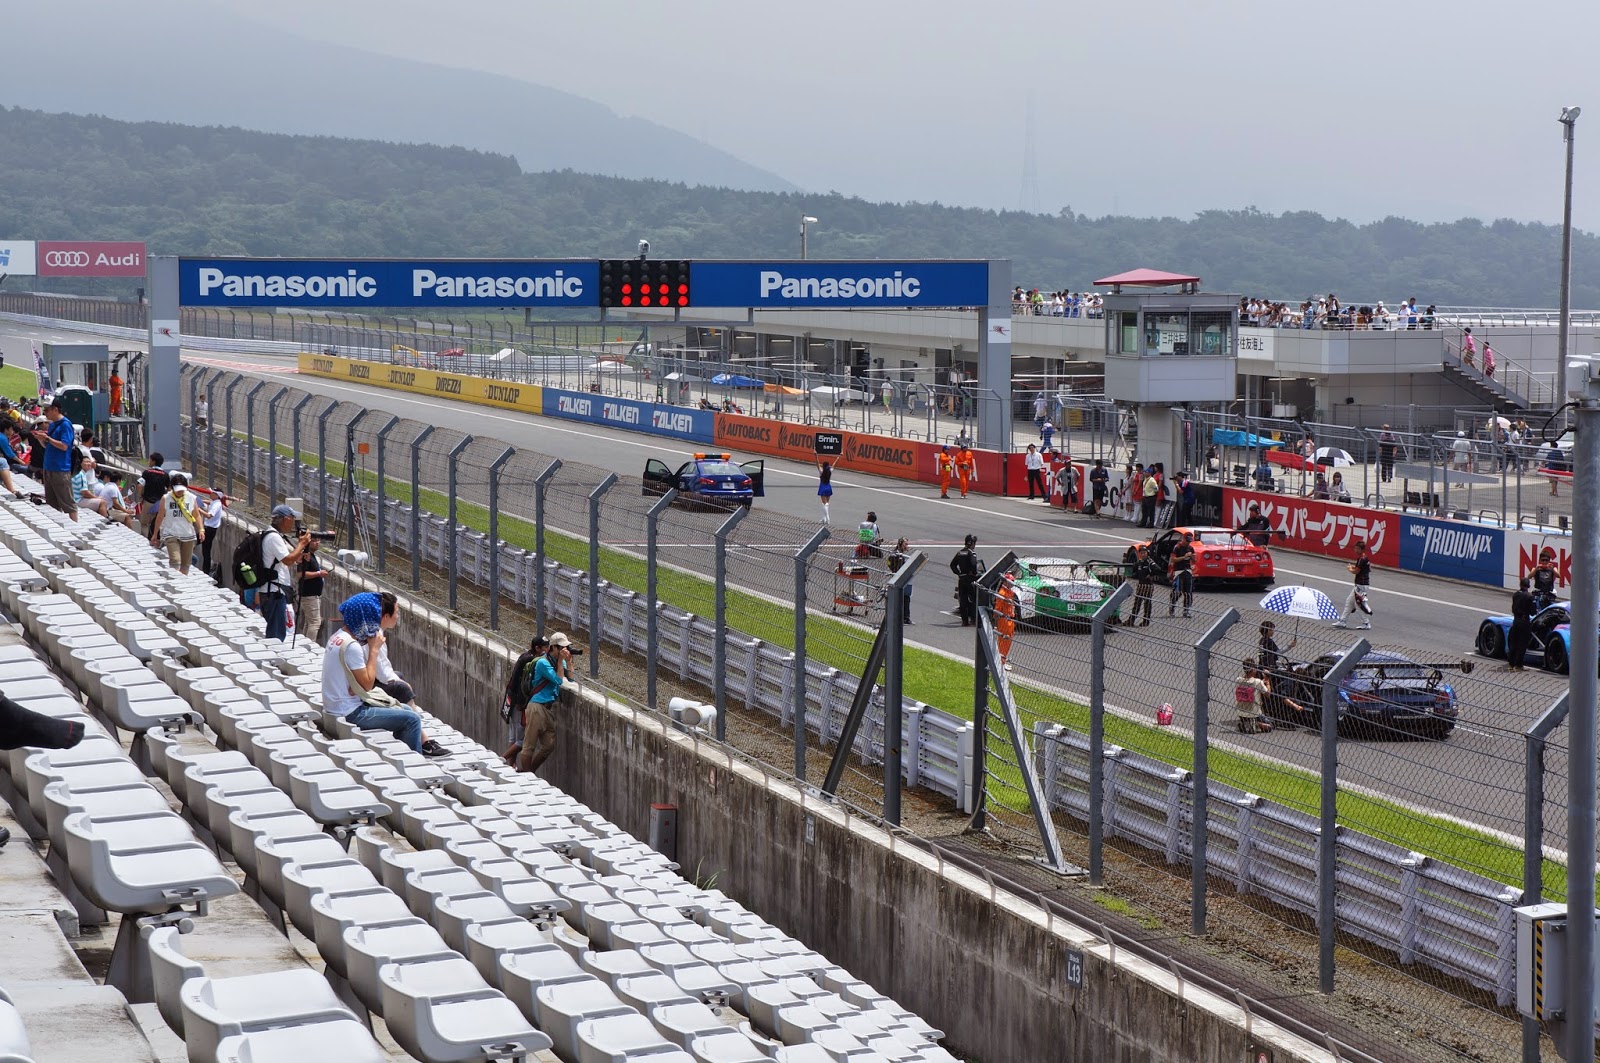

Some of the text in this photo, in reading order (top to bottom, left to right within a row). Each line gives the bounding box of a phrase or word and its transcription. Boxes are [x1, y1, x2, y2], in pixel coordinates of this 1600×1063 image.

[95, 253, 140, 266] Audi
[199, 268, 377, 298] Panasonic
[412, 269, 583, 298] Panasonic
[760, 270, 921, 298] Panasonic
[313, 359, 334, 373] DUNLOP
[390, 370, 416, 386] DUNLOP
[435, 377, 462, 394] DIREZZA
[487, 385, 520, 403] DUNLOP
[558, 396, 592, 416] FALKEN
[603, 402, 640, 425] FALKEN
[652, 410, 693, 433] FALKEN
[726, 423, 771, 442] AUTOBACS
[788, 432, 816, 450] AUTO
[818, 434, 840, 443] 5min.
[857, 444, 914, 466] AUTOBACS
[1409, 524, 1426, 538] NGK
[1067, 961, 1081, 984] L13
